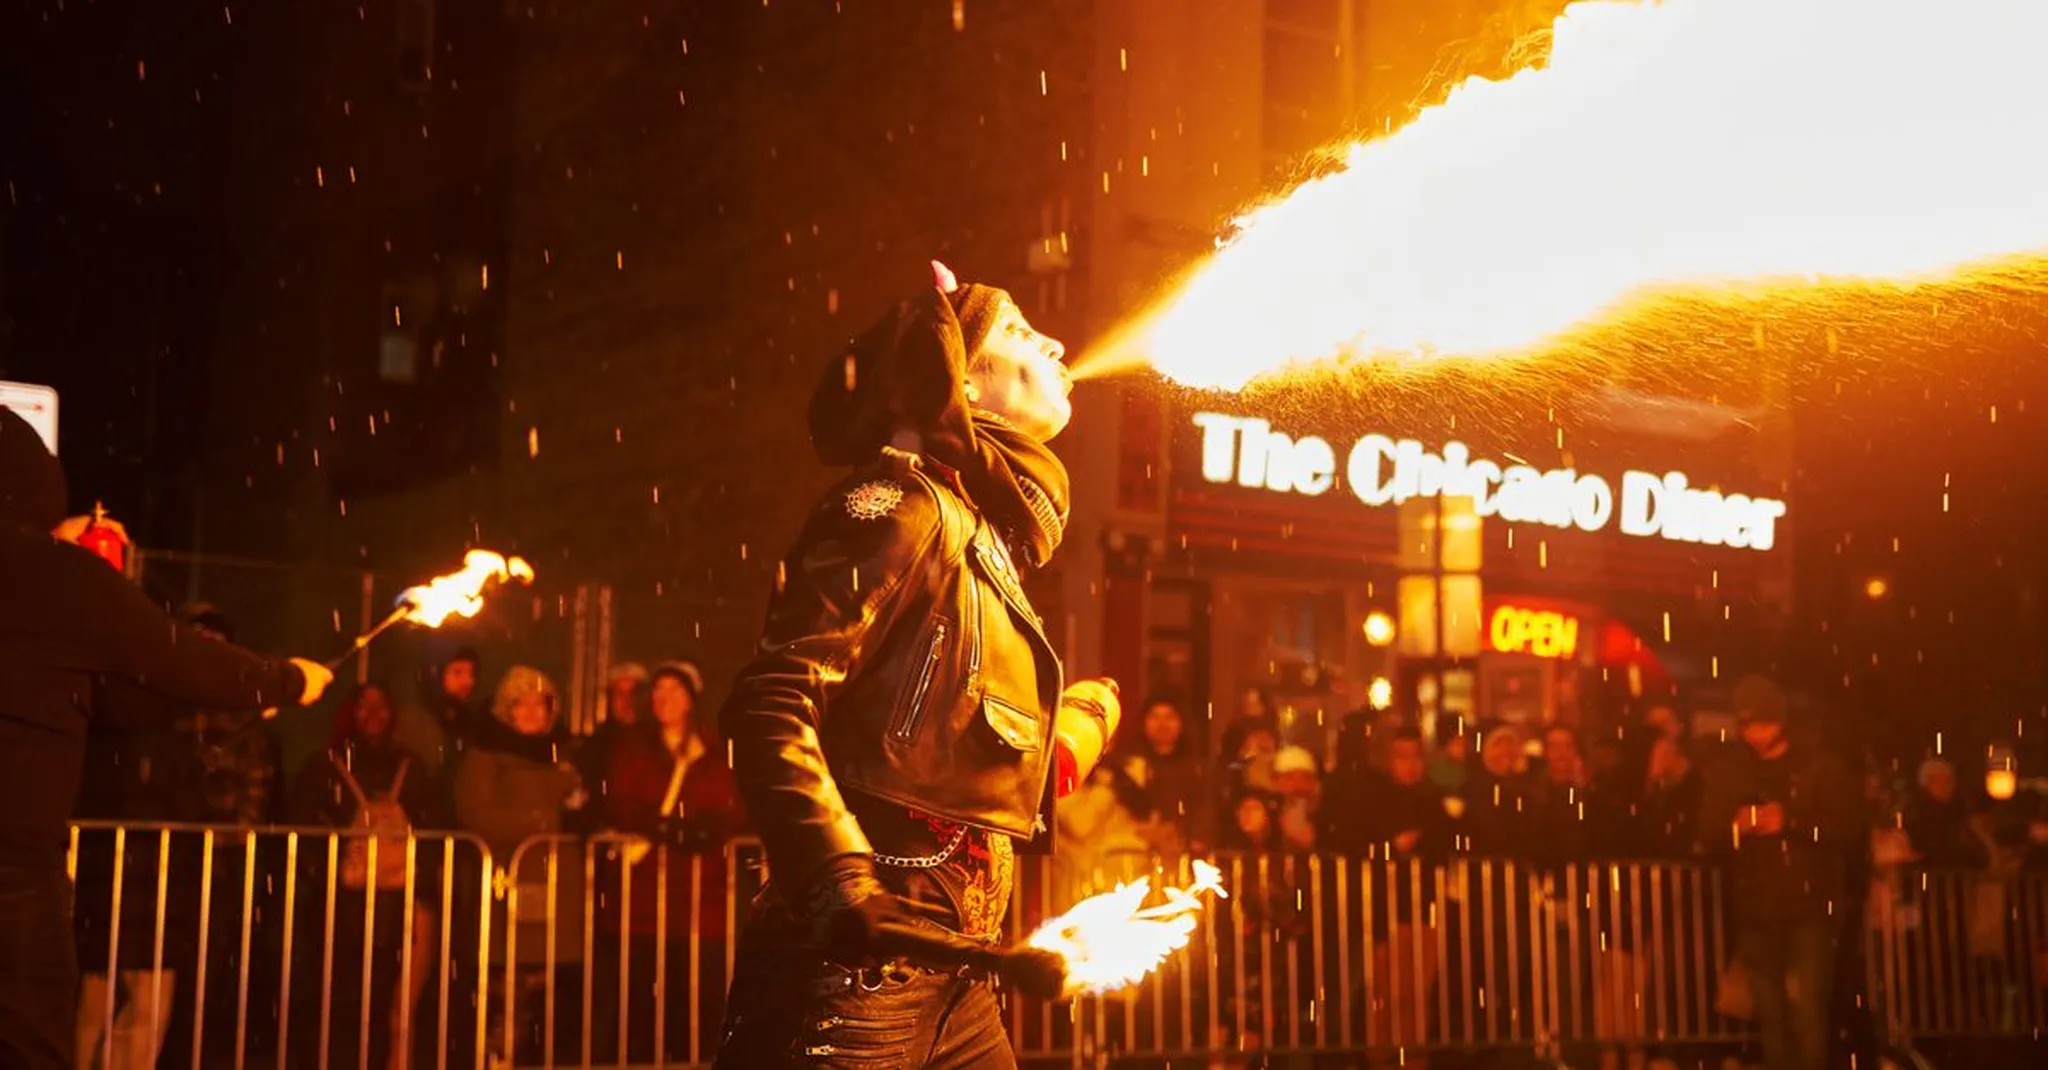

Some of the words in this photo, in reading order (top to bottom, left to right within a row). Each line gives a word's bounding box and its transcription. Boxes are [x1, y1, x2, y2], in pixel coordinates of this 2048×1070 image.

[1192, 411, 1335, 496] The
[1348, 433, 1612, 531] Chicago
[1620, 469, 1786, 551] Diner
[1491, 604, 1578, 659] OPEN
